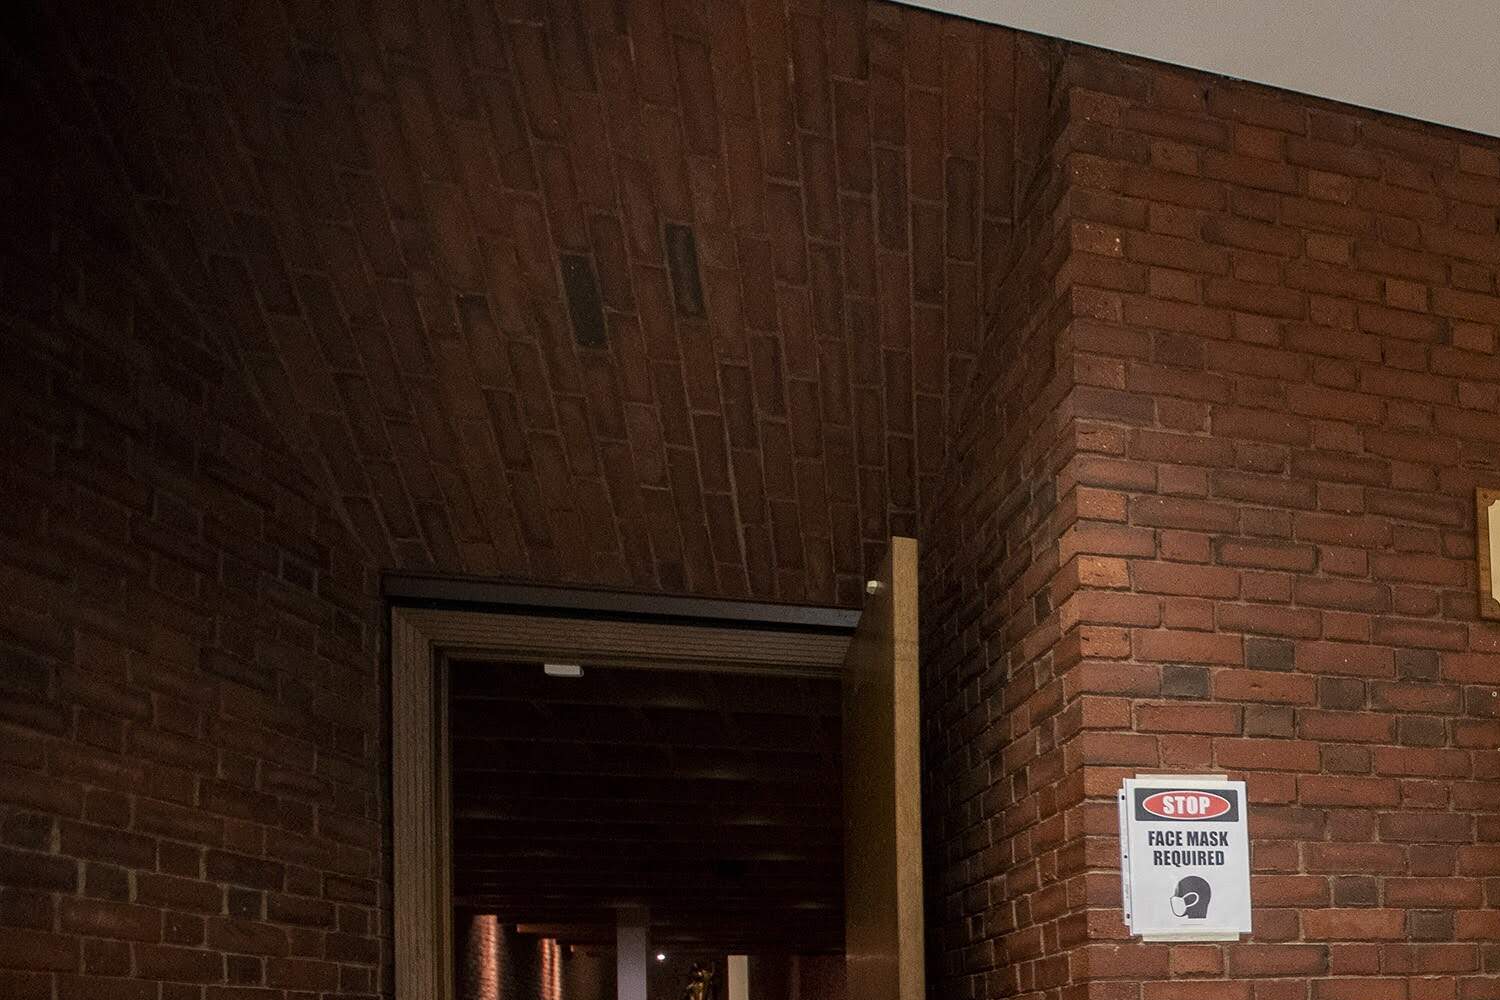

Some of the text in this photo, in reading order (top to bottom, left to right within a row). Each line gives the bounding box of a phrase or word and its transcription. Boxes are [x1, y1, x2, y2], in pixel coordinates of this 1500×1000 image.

[1162, 796, 1210, 814] STOP
[1148, 830, 1228, 846] FACE MASK
[1154, 850, 1224, 867] REQUIRED
